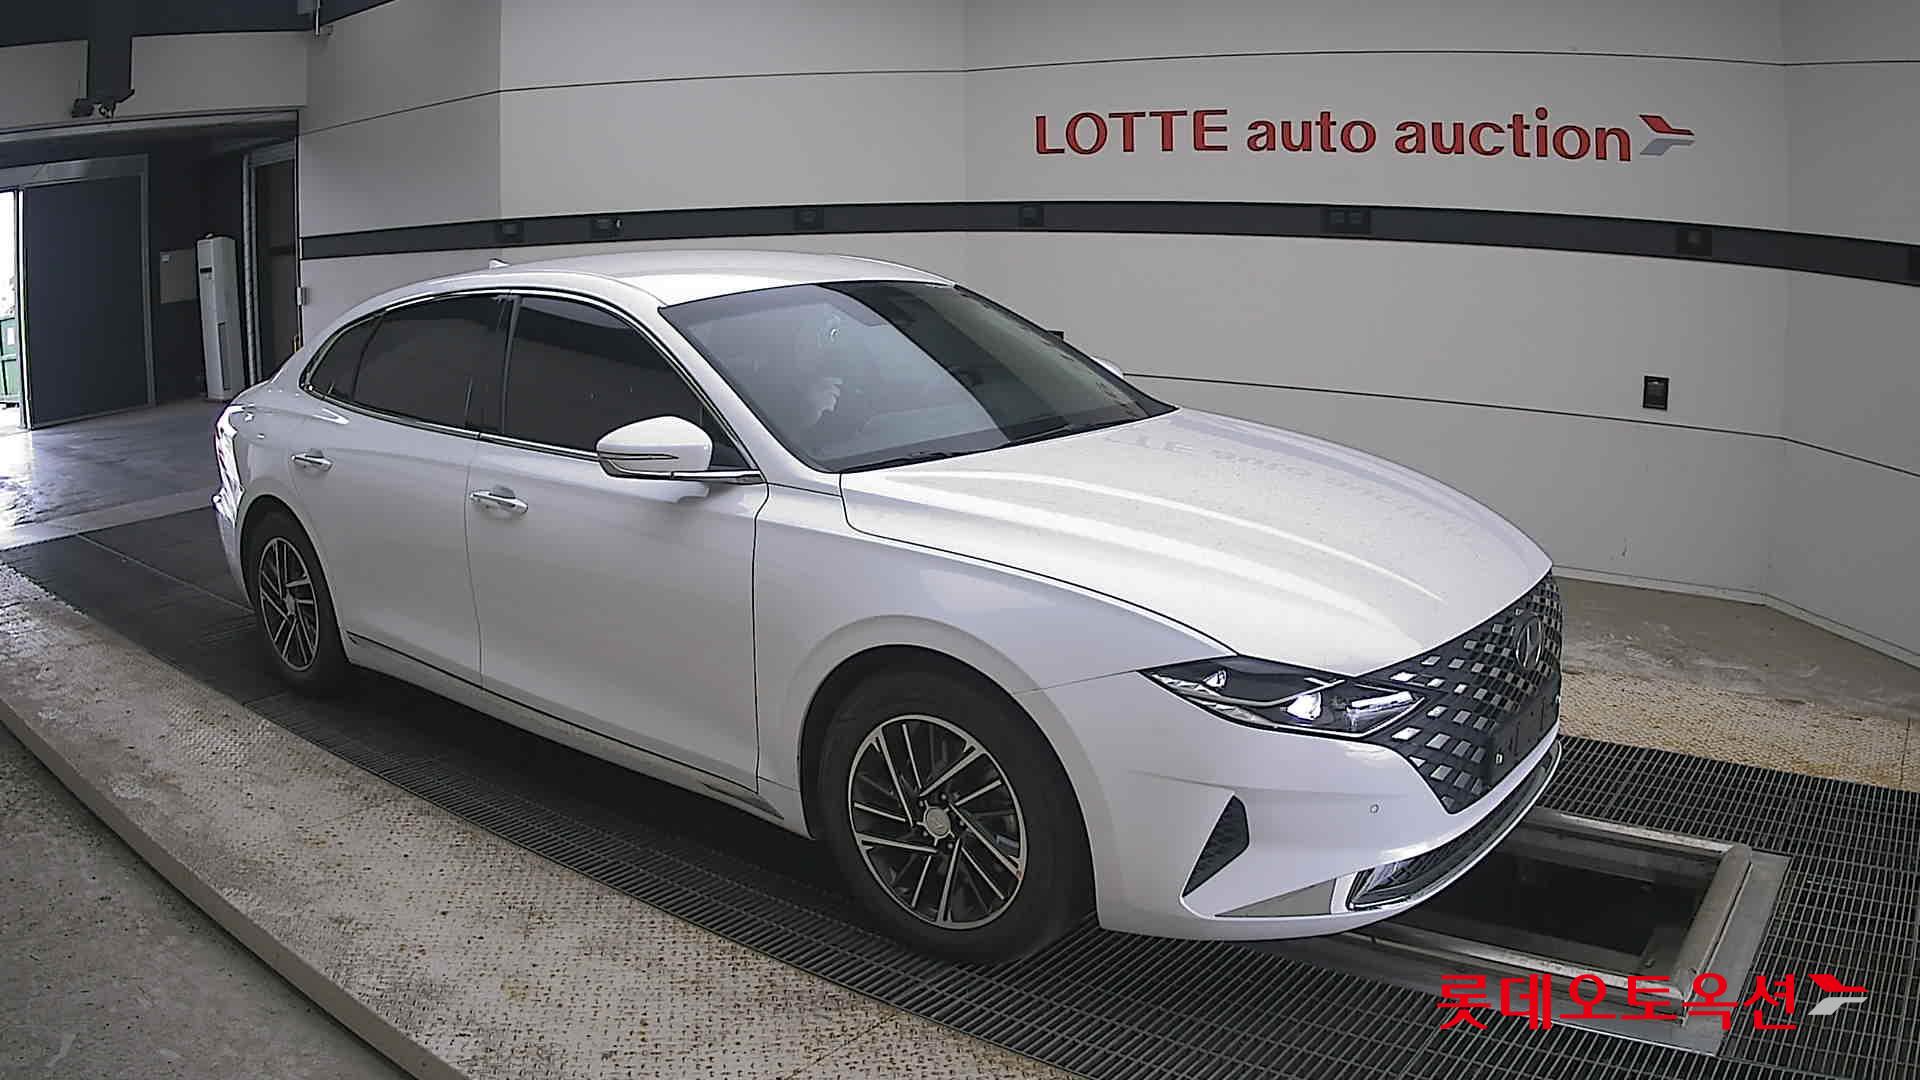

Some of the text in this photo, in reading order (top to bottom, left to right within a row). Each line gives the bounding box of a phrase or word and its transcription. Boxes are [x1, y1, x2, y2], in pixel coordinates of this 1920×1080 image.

[1035, 106, 1632, 162] LOTTE auto auction
